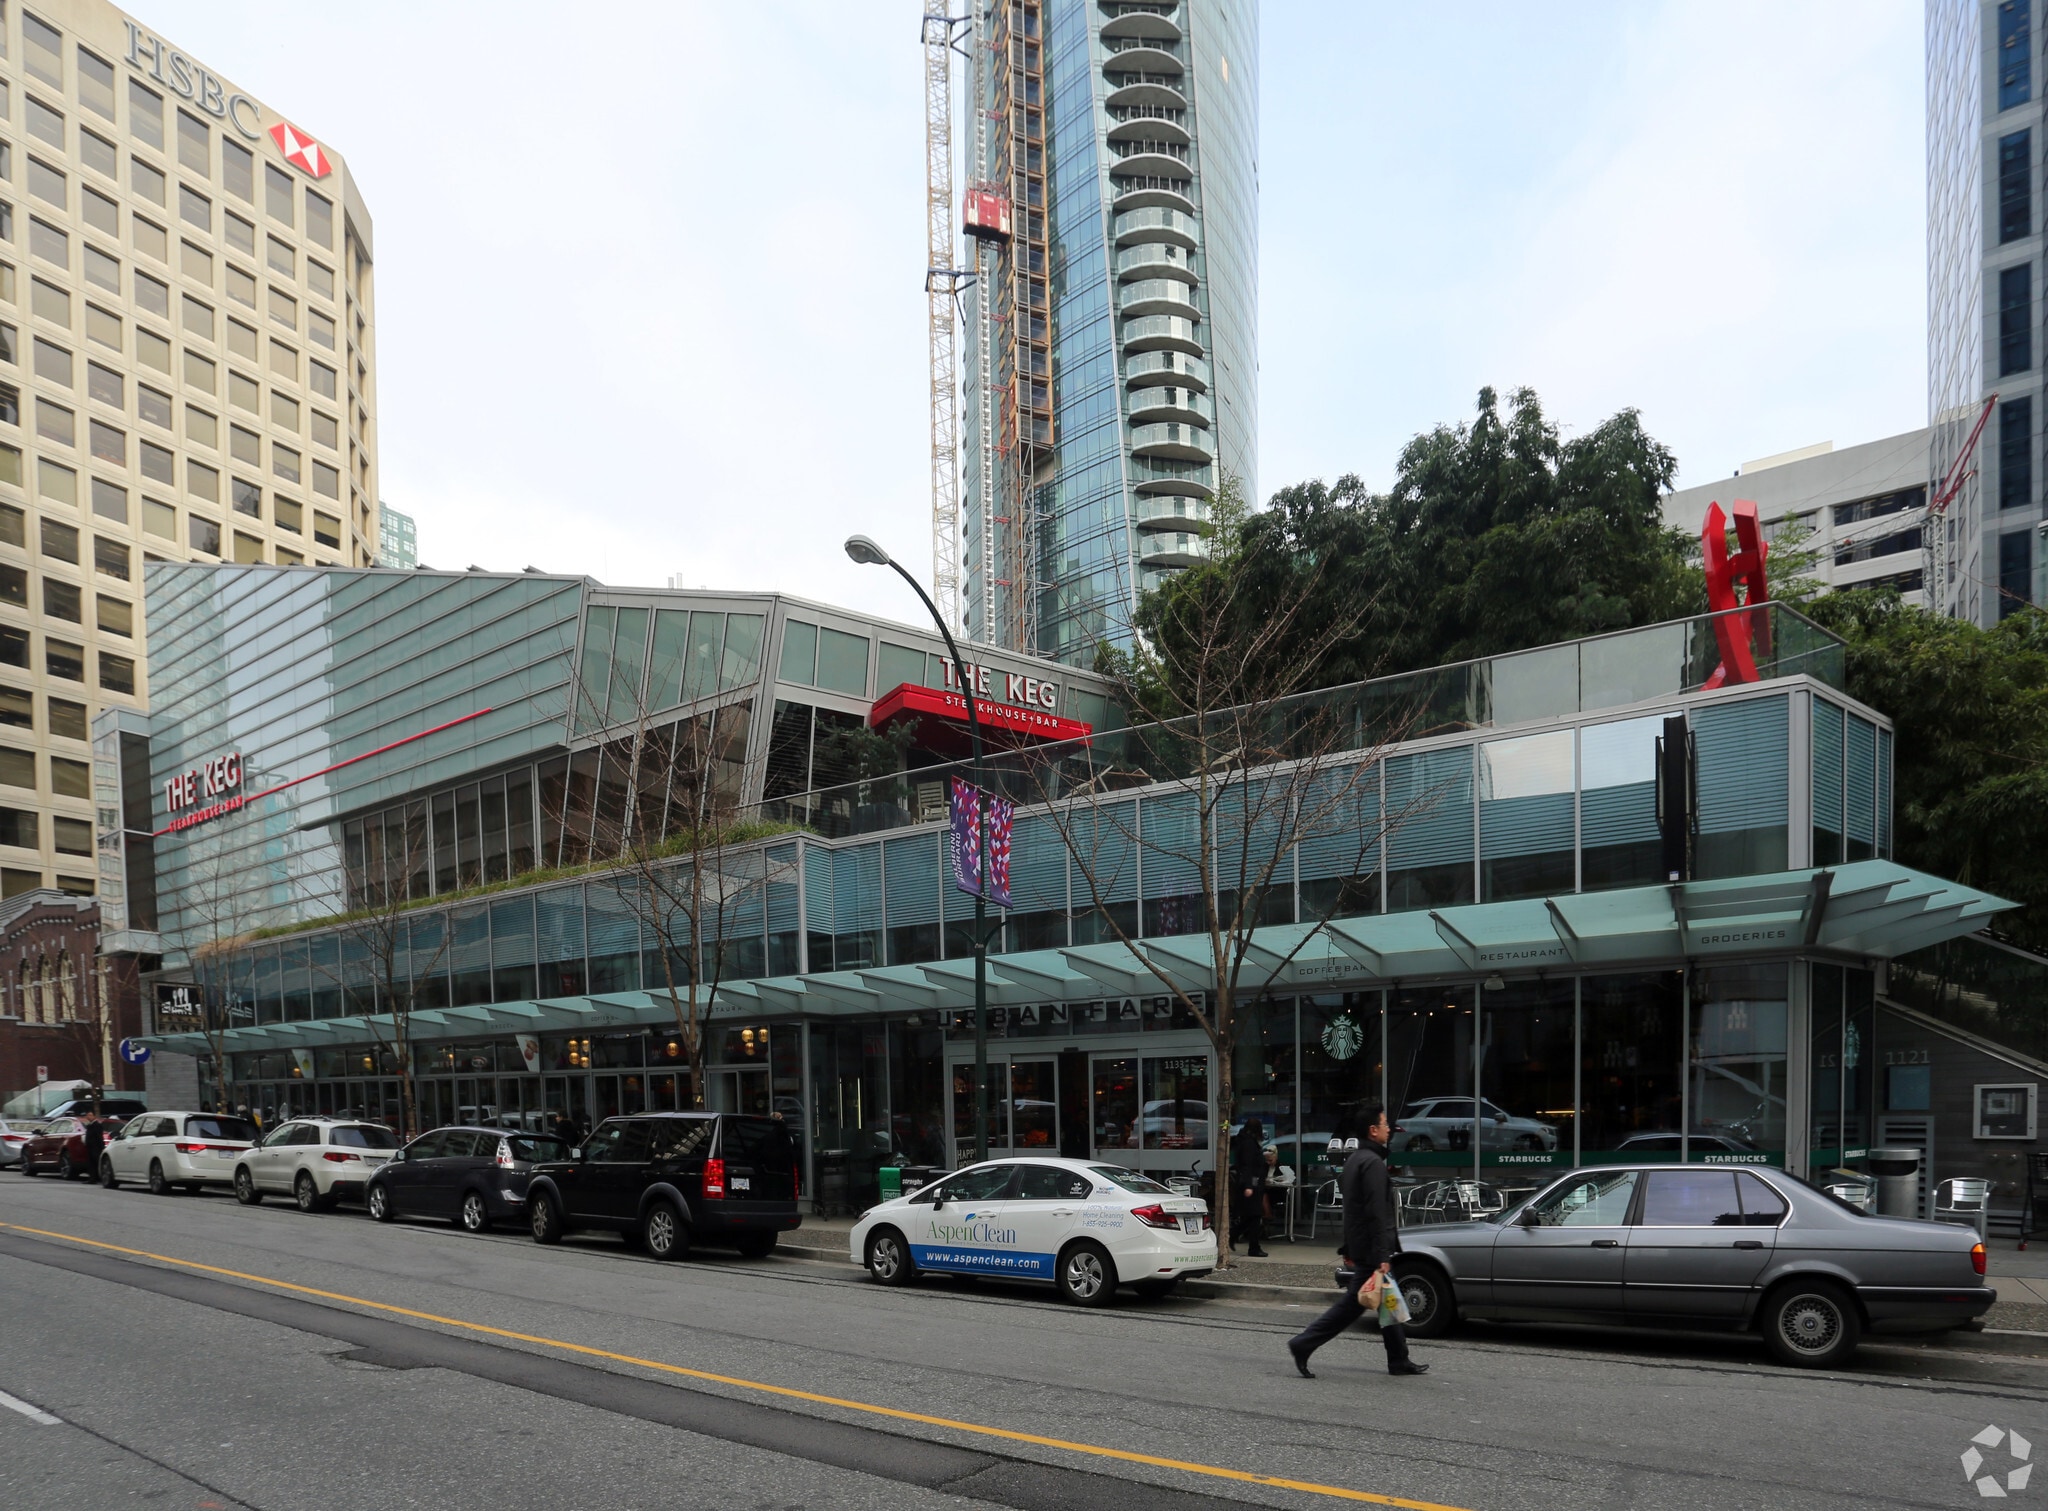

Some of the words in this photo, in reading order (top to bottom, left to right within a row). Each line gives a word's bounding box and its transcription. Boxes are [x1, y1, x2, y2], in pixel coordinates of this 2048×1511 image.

[123, 17, 261, 139] HSBC
[939, 656, 991, 695] THE
[1006, 673, 1056, 709] KEG
[164, 769, 198, 813] THE
[204, 751, 242, 798] KEG
[1701, 930, 1786, 944] GROCERIES
[1480, 948, 1565, 962] RESTAURANT
[1299, 966, 1342, 976] COFFEE
[938, 1004, 1068, 1028] URBAN
[1886, 1049, 1931, 1065] 1121
[1164, 1060, 1185, 1070] 1133
[1498, 1155, 1552, 1163] STARBUCKS
[1704, 1155, 1767, 1163] STARBUCKS
[1844, 1149, 1866, 1159] STARBUCKS
[1100, 1212, 1124, 1220] Cleaning
[926, 1221, 1016, 1244] AspenClean
[926, 1252, 1040, 1269] www.aspenclean.com
